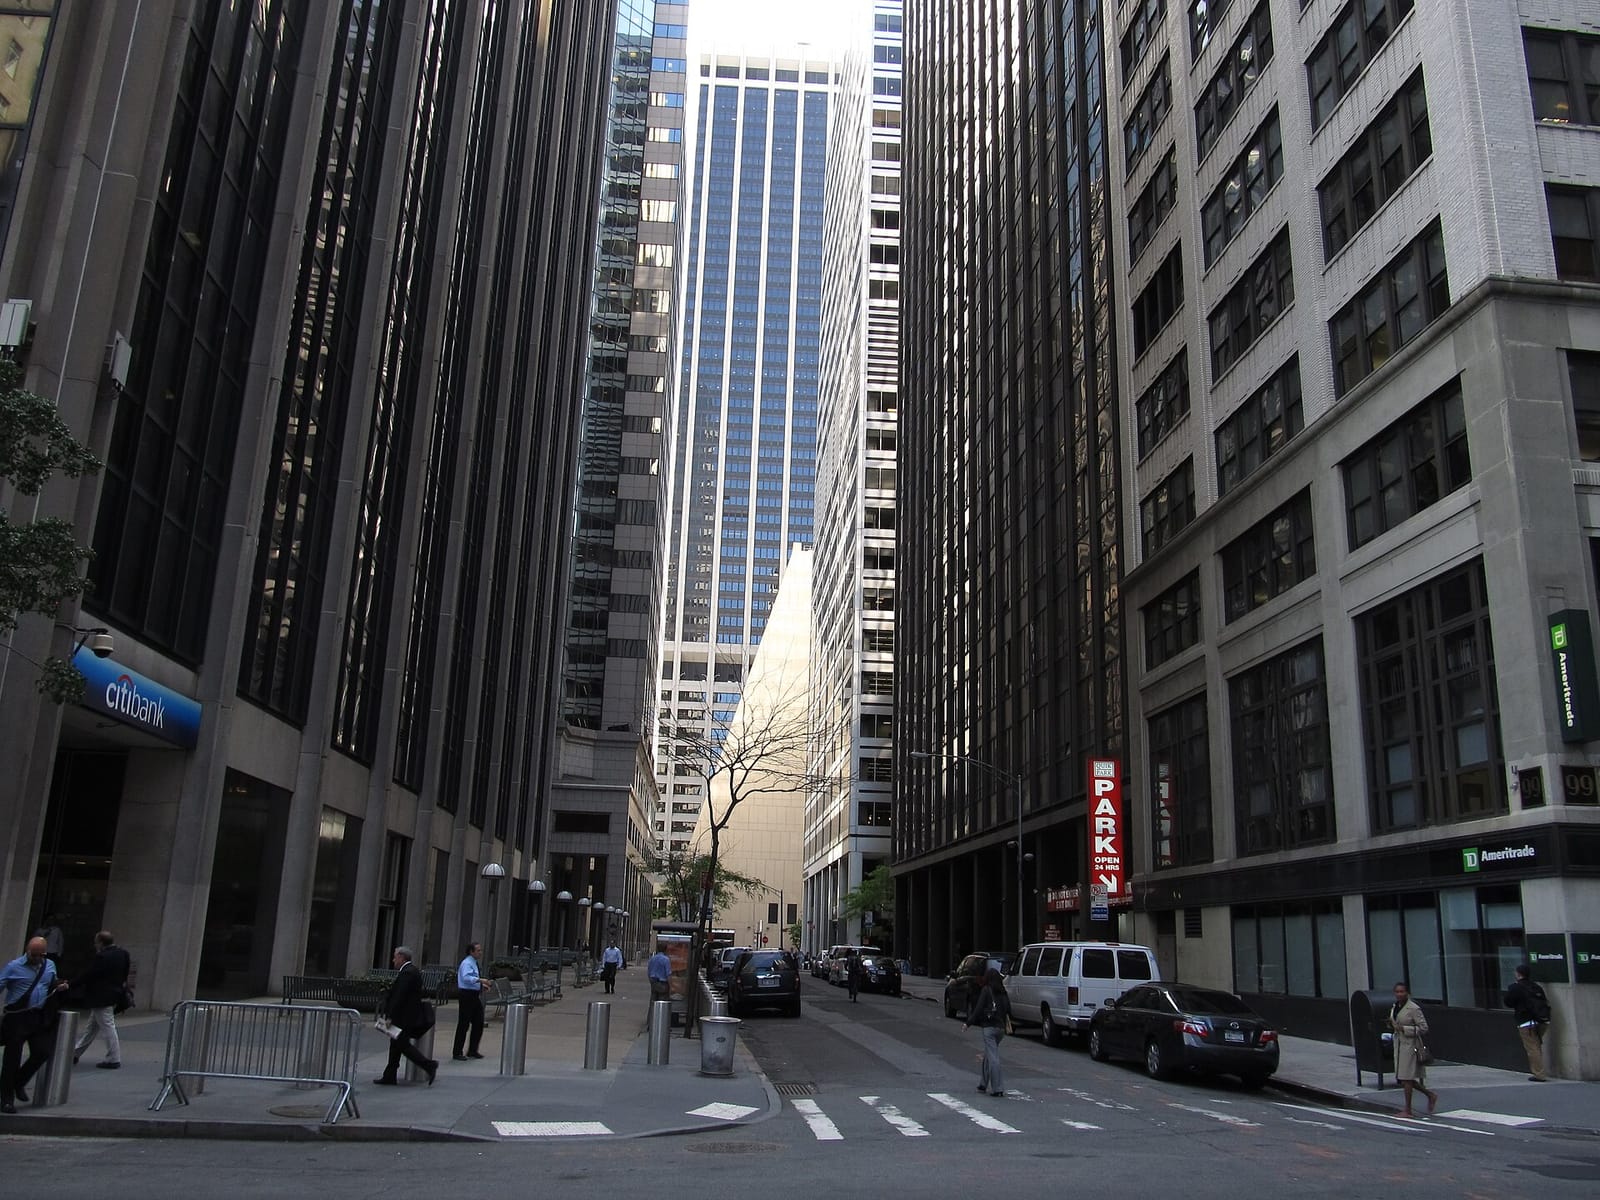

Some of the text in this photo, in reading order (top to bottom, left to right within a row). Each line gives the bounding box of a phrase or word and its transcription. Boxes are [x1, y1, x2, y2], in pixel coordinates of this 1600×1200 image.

[105, 681, 165, 729] citibank
[1559, 652, 1574, 728] Ameritrade
[1566, 774, 1593, 796] 99
[1094, 779, 1117, 854] PARK
[1094, 856, 1120, 864] OPEN
[1481, 845, 1535, 862] Ameritrade
